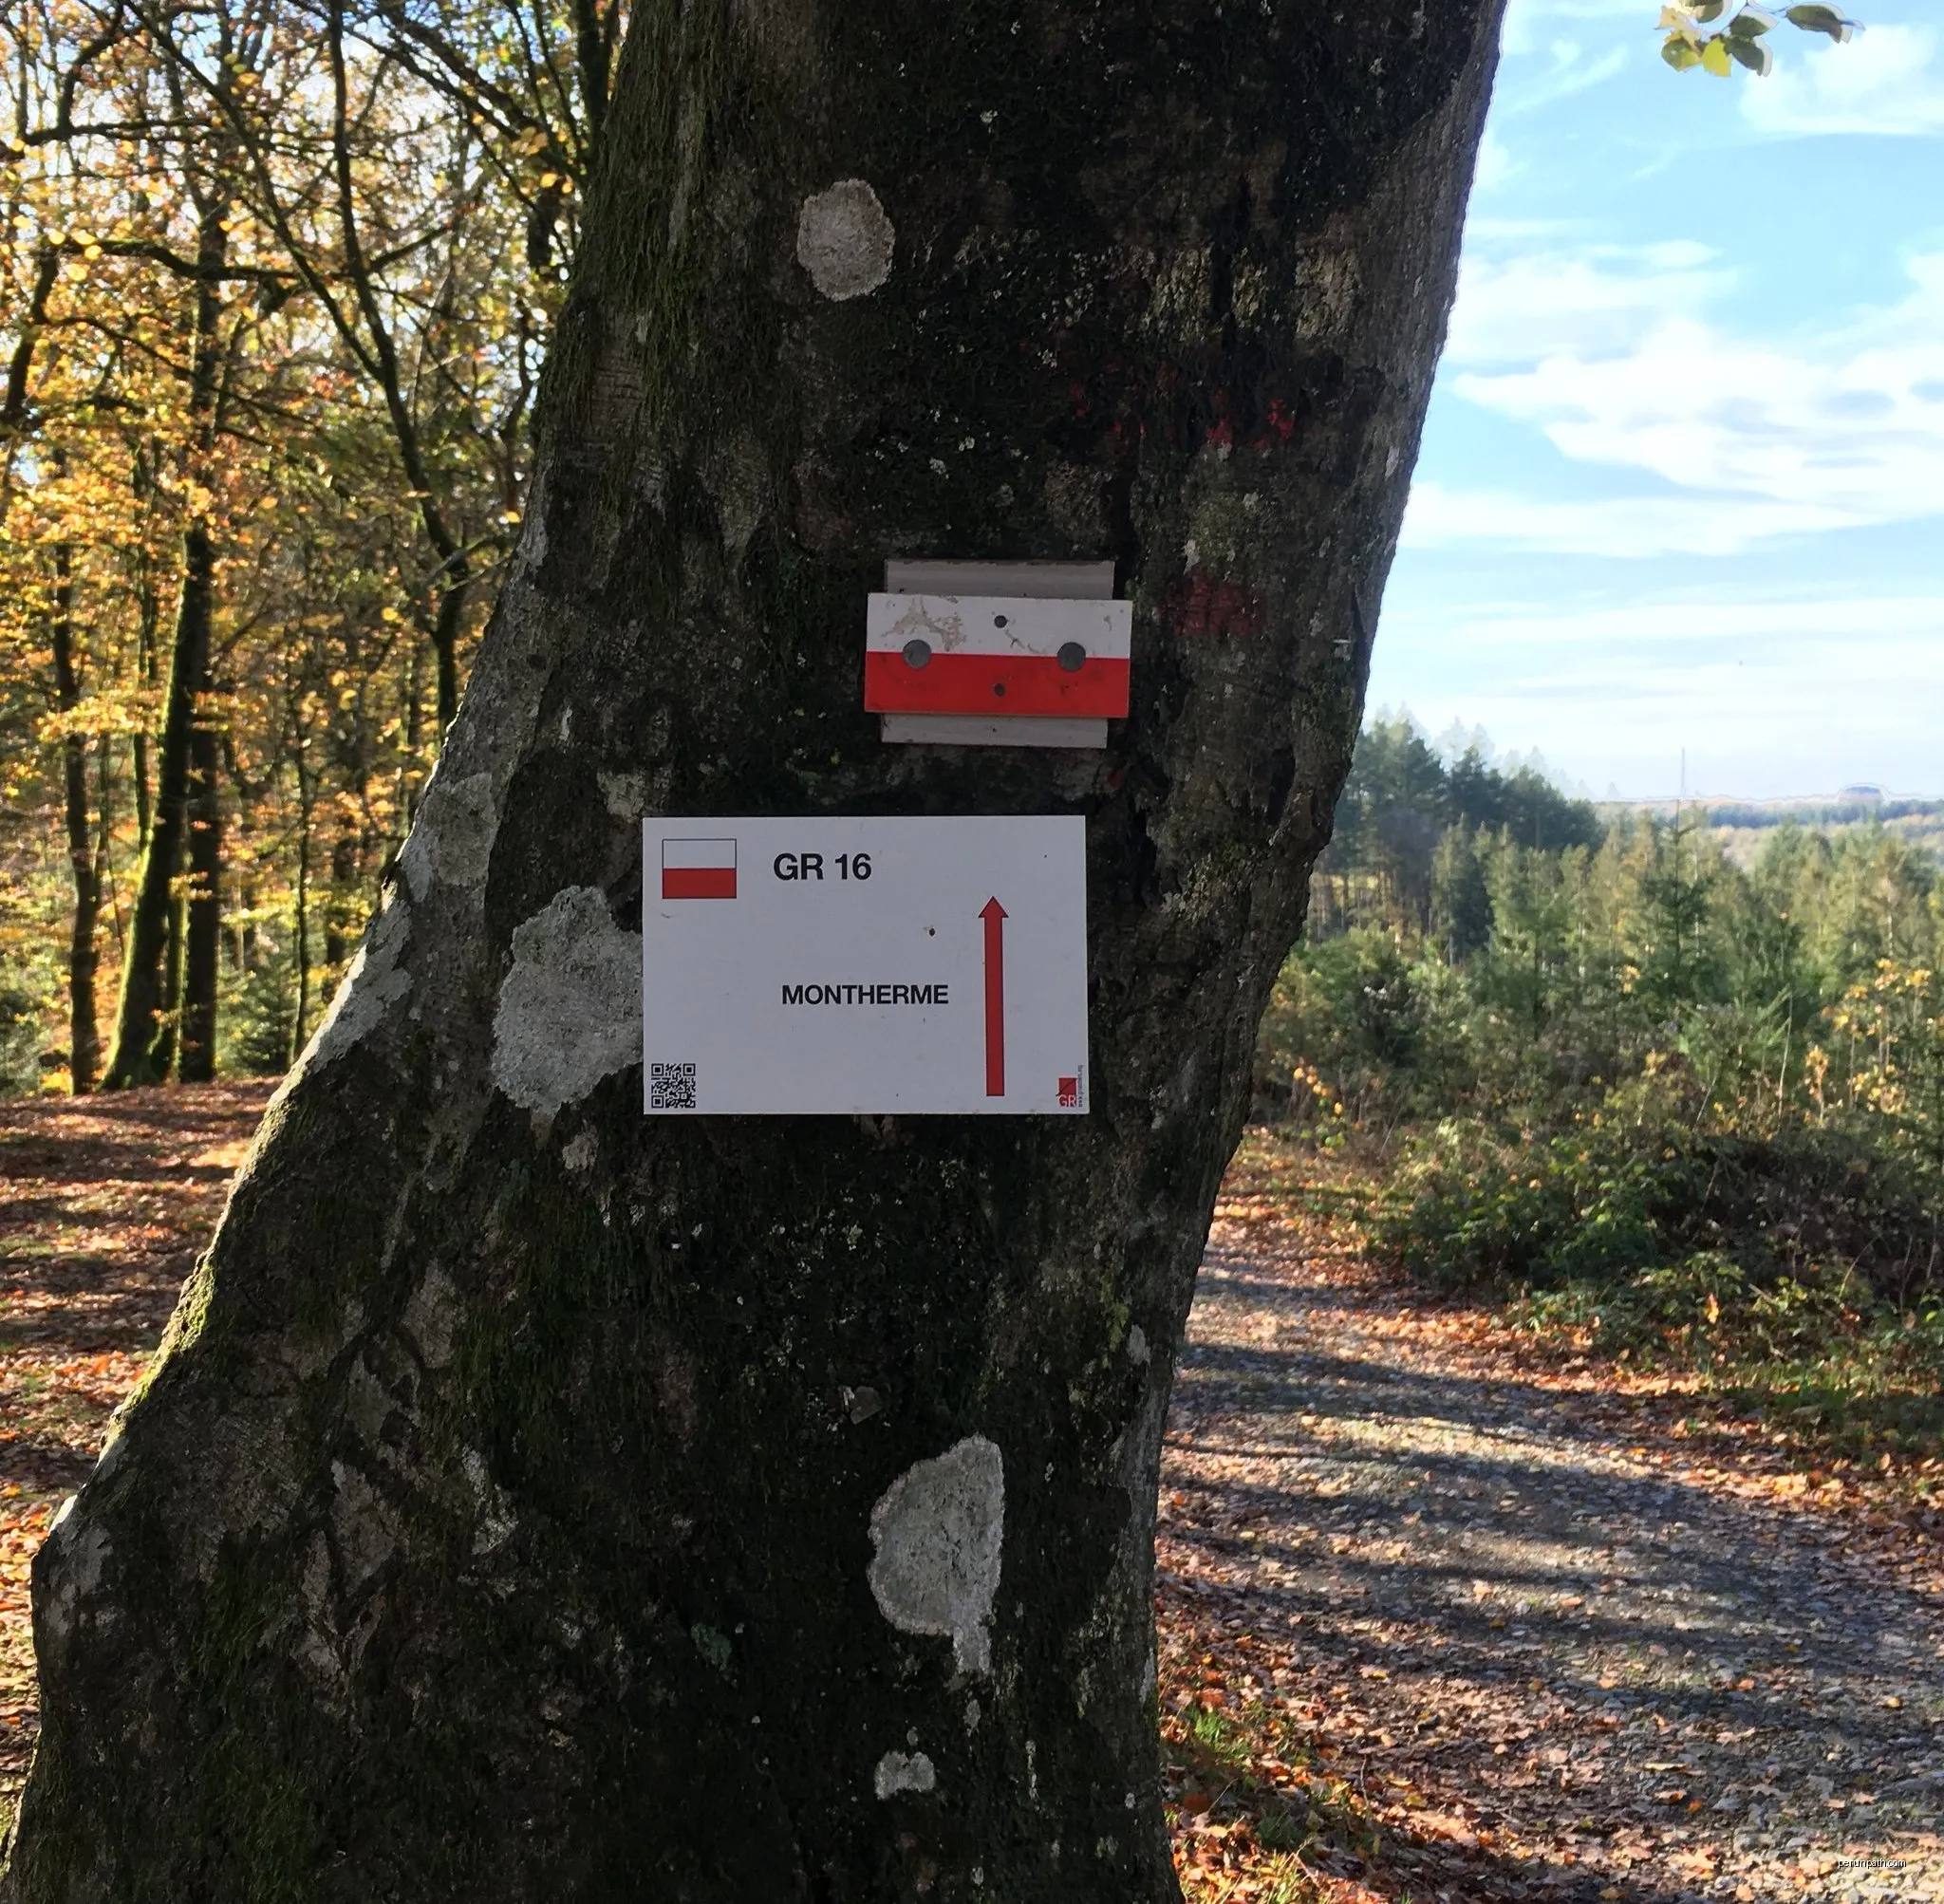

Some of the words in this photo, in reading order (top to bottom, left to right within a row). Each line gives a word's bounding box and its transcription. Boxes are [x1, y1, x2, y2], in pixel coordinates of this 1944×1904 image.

[773, 852, 824, 881] GR
[835, 852, 872, 881] 16
[781, 983, 949, 1005] MONTHERME
[1058, 1093, 1076, 1108] GR
